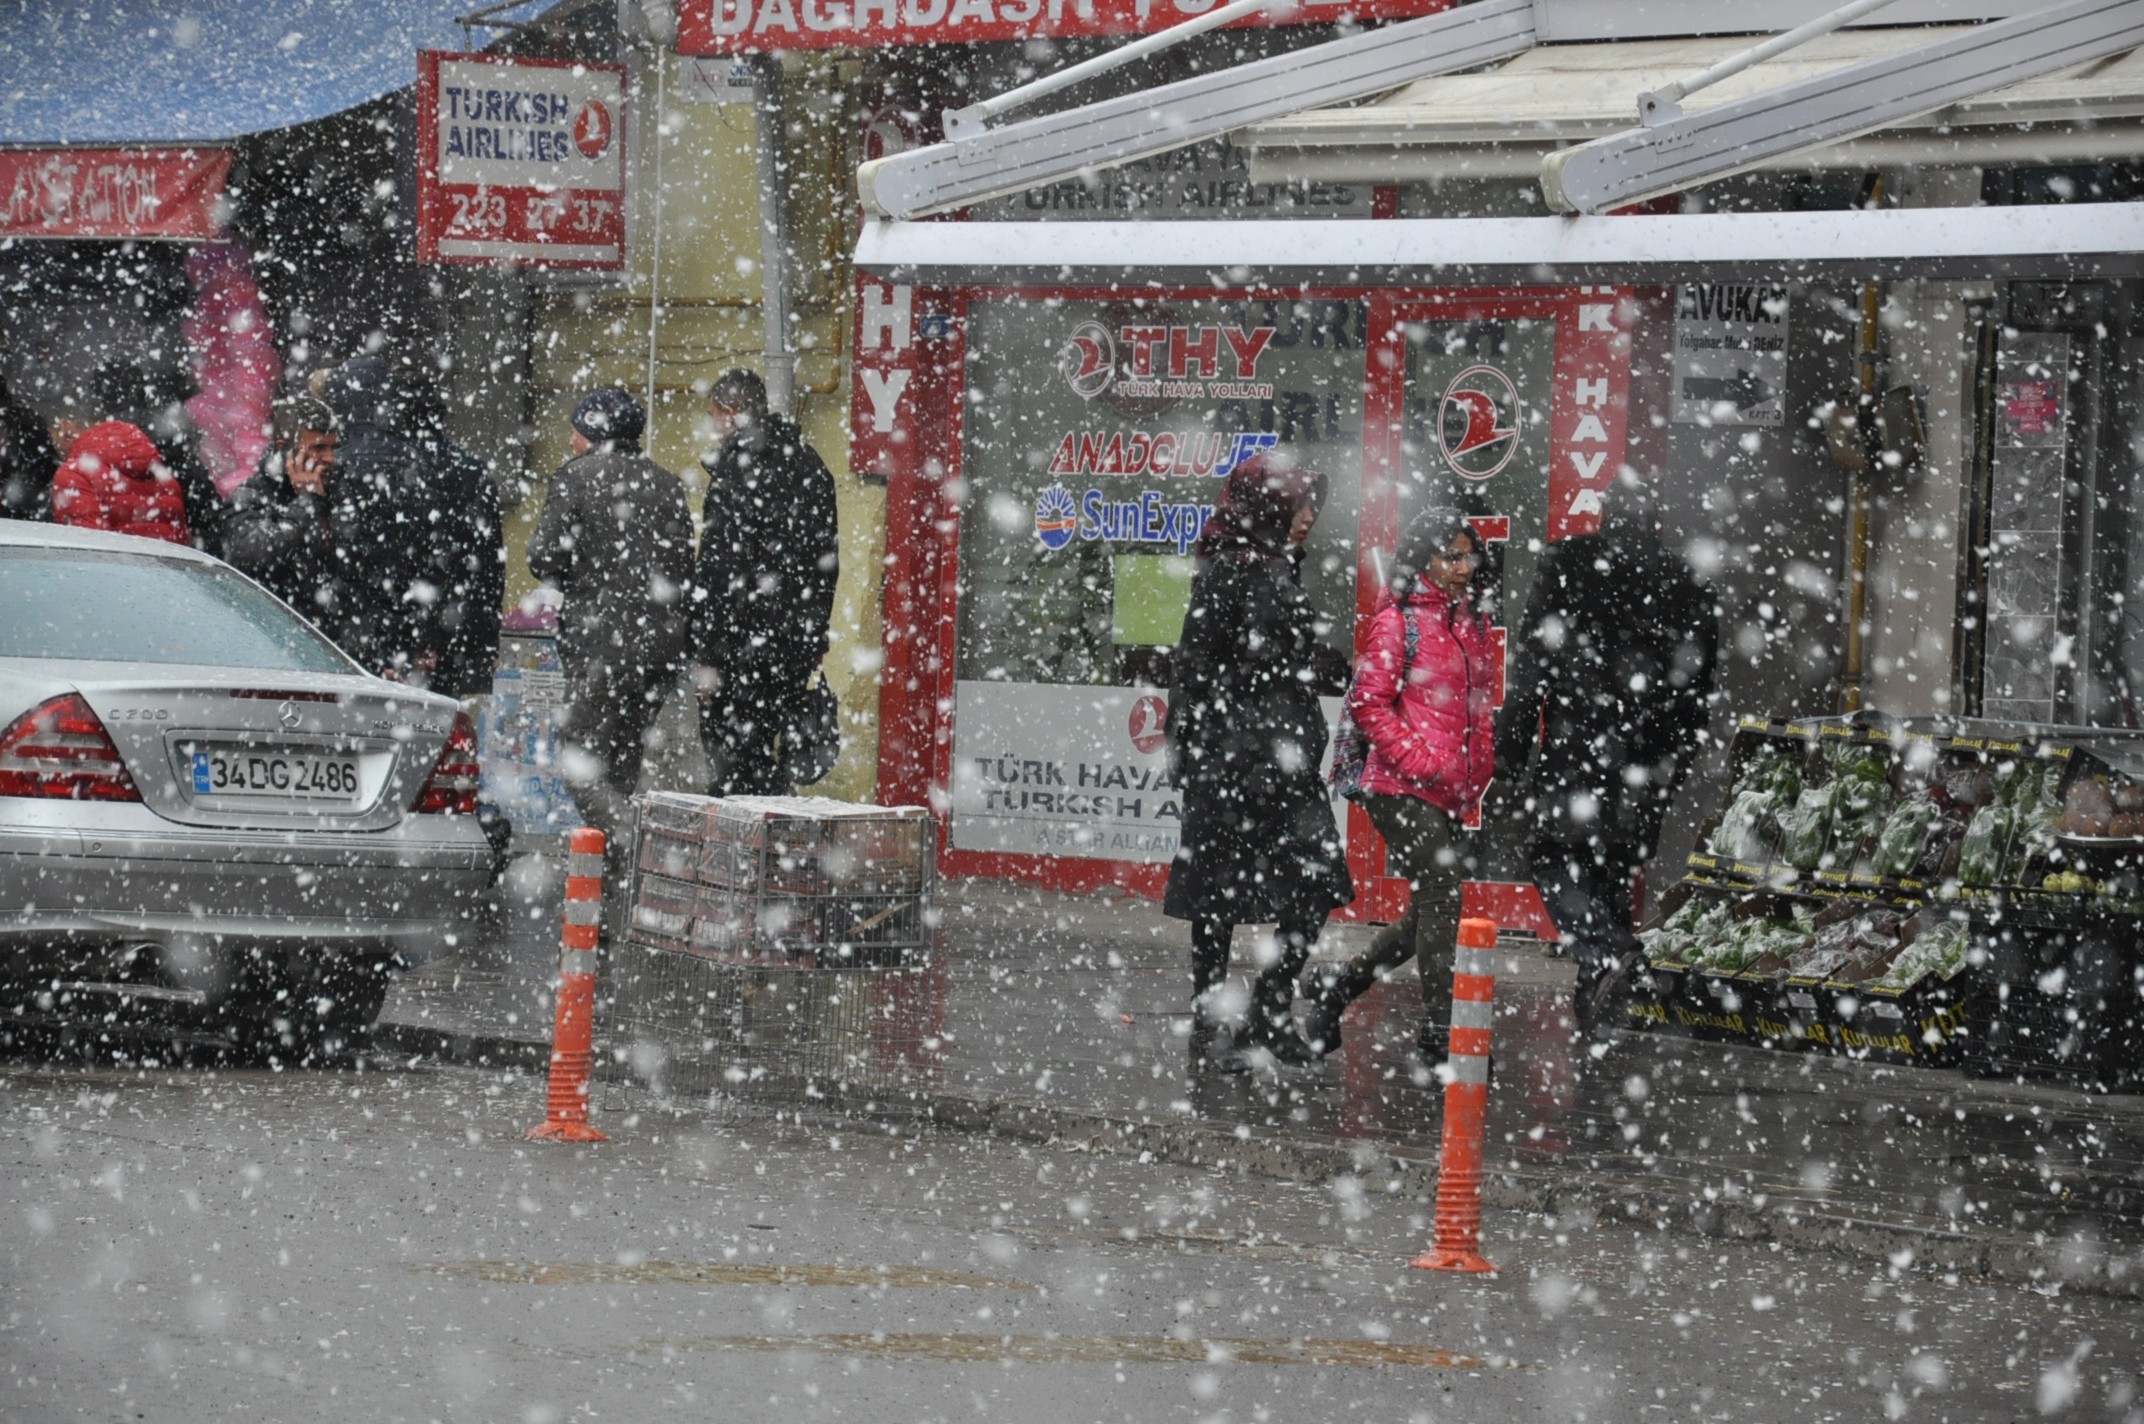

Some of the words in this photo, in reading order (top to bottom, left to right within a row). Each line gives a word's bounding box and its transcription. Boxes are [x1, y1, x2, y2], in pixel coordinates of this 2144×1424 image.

[446, 87, 569, 125] TURKISH
[446, 126, 569, 163] AIRLINES
[0, 163, 157, 225] AYSTATION
[453, 194, 507, 228] 223
[527, 198, 561, 230] 27
[572, 199, 609, 232] 37
[1680, 284, 1787, 323] AVUKAT
[1120, 325, 1276, 379] THY
[1118, 378, 1160, 397] TÜRK
[1162, 380, 1205, 398] HAVA
[1209, 383, 1274, 400] YOLLARI
[1567, 377, 1609, 515] HAVA
[108, 709, 121, 720] C
[126, 708, 168, 720] 200
[211, 757, 246, 788] 34
[248, 758, 290, 790] DG
[295, 760, 357, 793] 2486
[974, 753, 1066, 787] TÜRK
[980, 789, 1142, 819] TURKISH
[1056, 830, 1105, 850] STR
[1840, 1023, 1916, 1056] KUTLULAR
